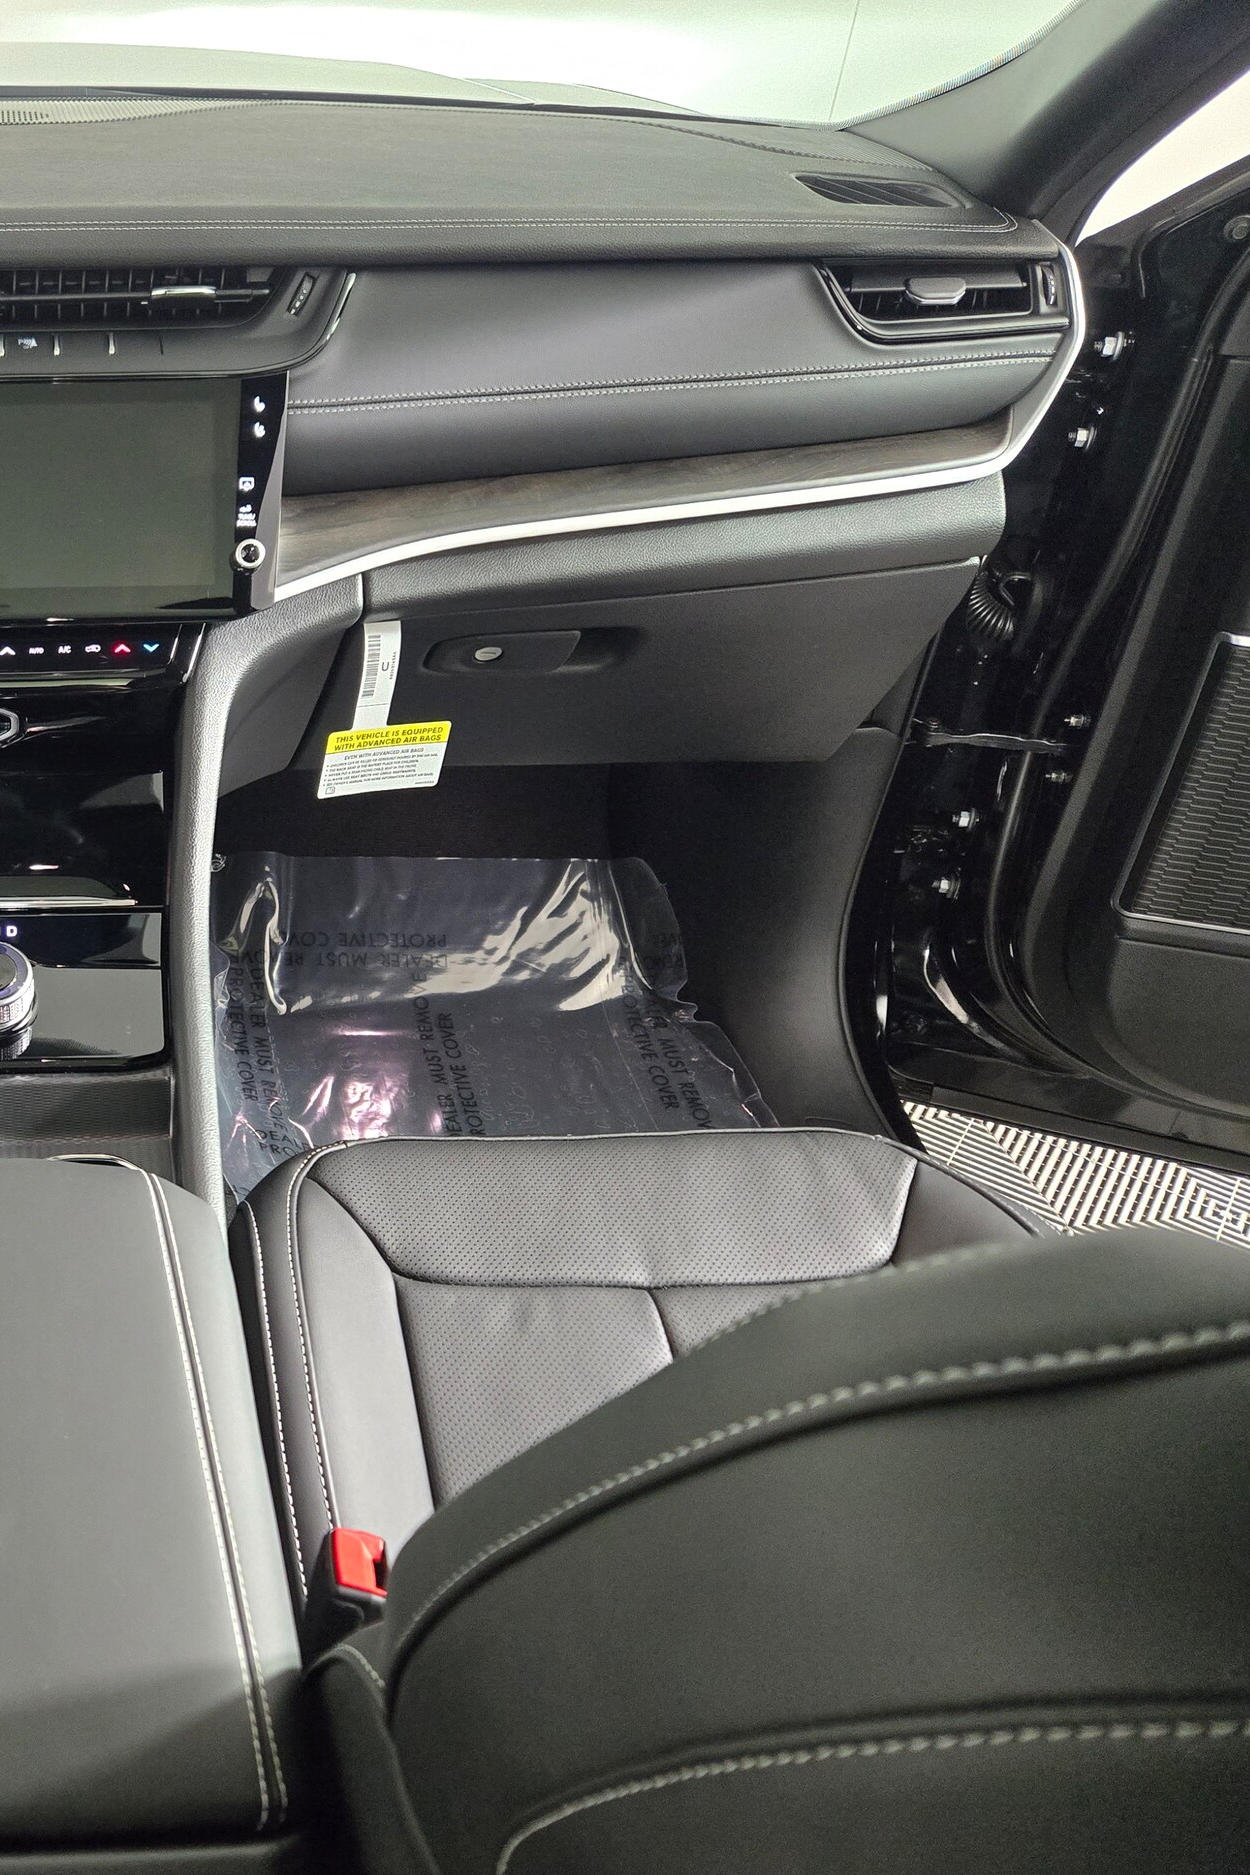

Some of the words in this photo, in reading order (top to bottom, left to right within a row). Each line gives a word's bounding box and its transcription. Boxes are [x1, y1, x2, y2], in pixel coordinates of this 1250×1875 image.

[334, 743, 355, 751] WITH
[356, 737, 401, 749] ADVANCED
[419, 734, 442, 742] BAGS
[336, 735, 354, 743] THIS
[356, 730, 390, 741] VEHICLE
[401, 727, 444, 736] EQUIPPED
[337, 932, 447, 948] PROTECTIVE
[315, 952, 368, 967] MUST
[230, 961, 249, 1055] PROTECTIVE
[438, 1012, 461, 1059] COVER
[253, 1037, 274, 1075] MUST
[423, 1047, 449, 1085] MUST
[659, 1038, 689, 1074] MUST
[237, 1061, 258, 1101] COVER
[450, 1064, 486, 1136] ROTECTIVE
[649, 1065, 681, 1109] COVER
